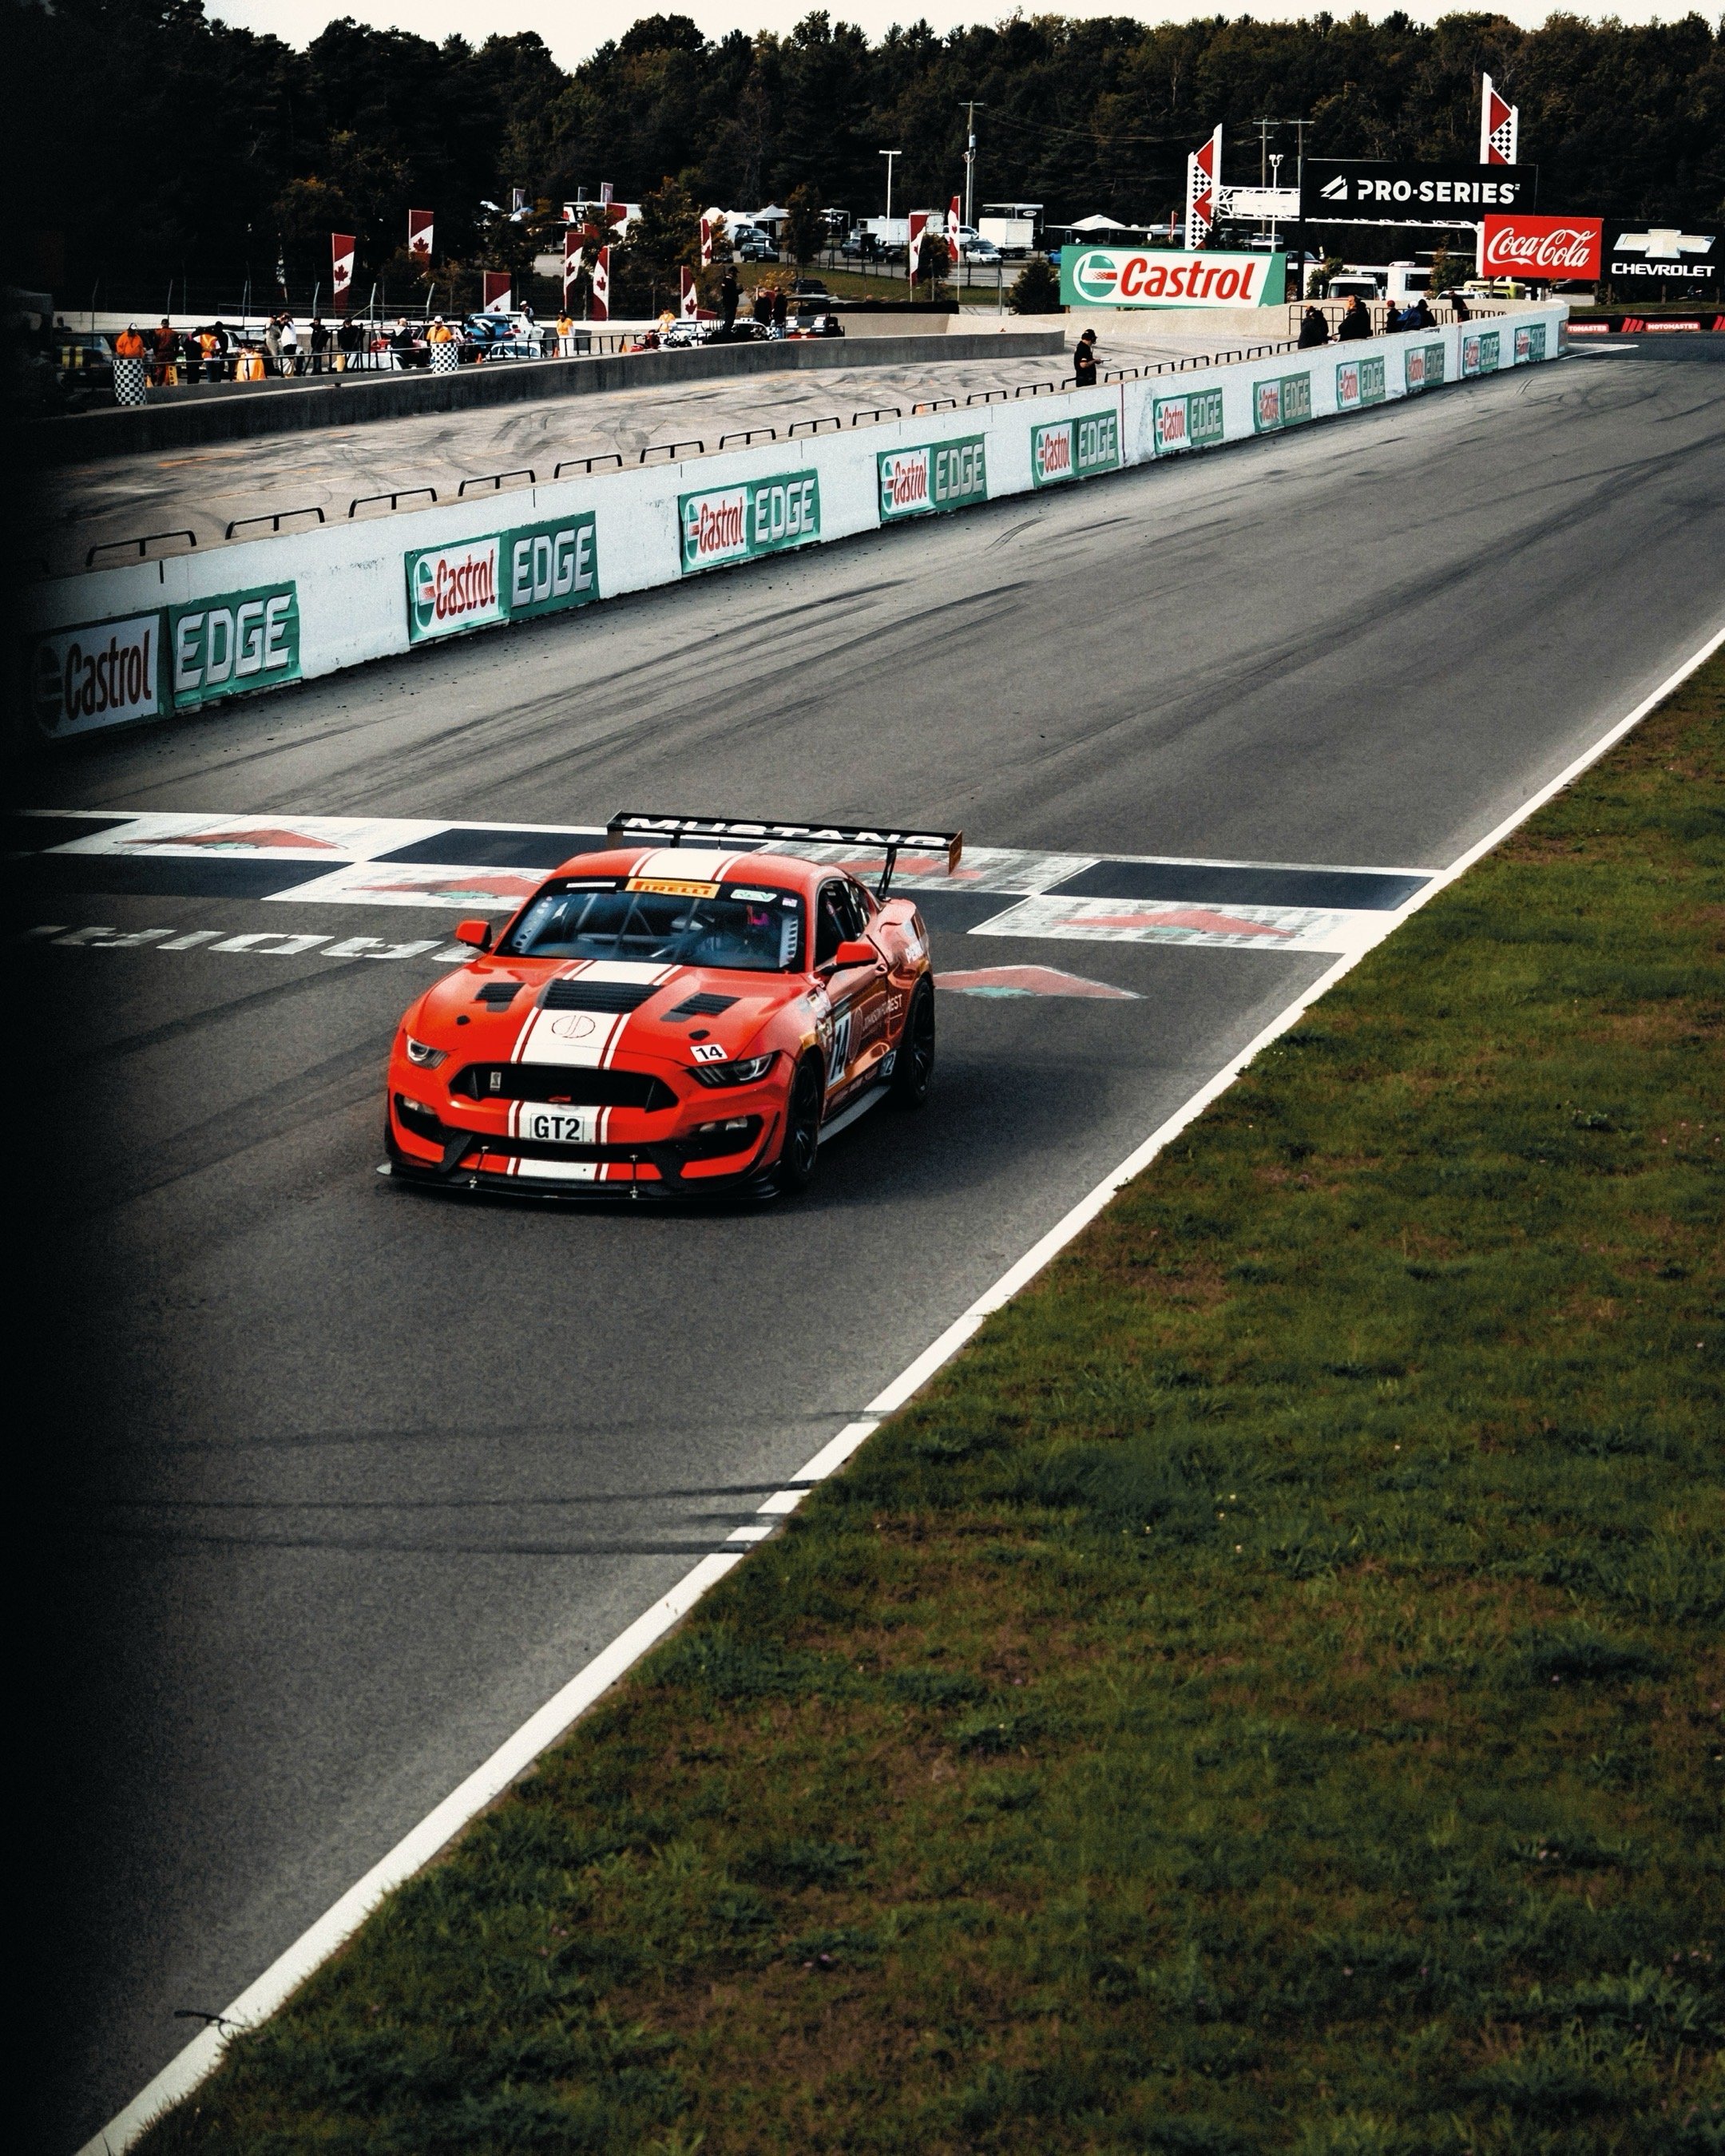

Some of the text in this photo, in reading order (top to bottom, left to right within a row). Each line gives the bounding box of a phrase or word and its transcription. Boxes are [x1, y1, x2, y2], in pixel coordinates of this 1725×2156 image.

[1486, 227, 1597, 268] Coca-Cola
[1120, 257, 1255, 299] Castrol
[1611, 263, 1715, 277] CHEVROLET
[1284, 378, 1310, 419] EDGE
[1362, 361, 1384, 398] EDGE
[1164, 393, 1222, 442] Castrol EDGE
[1044, 415, 1116, 474] Castrol EDGE
[894, 442, 985, 505] Castrol EDGE
[700, 478, 816, 554] Castrol EDGE
[435, 523, 595, 620] Castrol EDGE
[65, 593, 294, 720] Castrol EDGE
[625, 816, 950, 846] MUSTANG
[632, 881, 713, 895] PIRELLI
[696, 1046, 724, 1060] 14
[831, 1018, 849, 1080] 14
[533, 1115, 581, 1141] GT2
